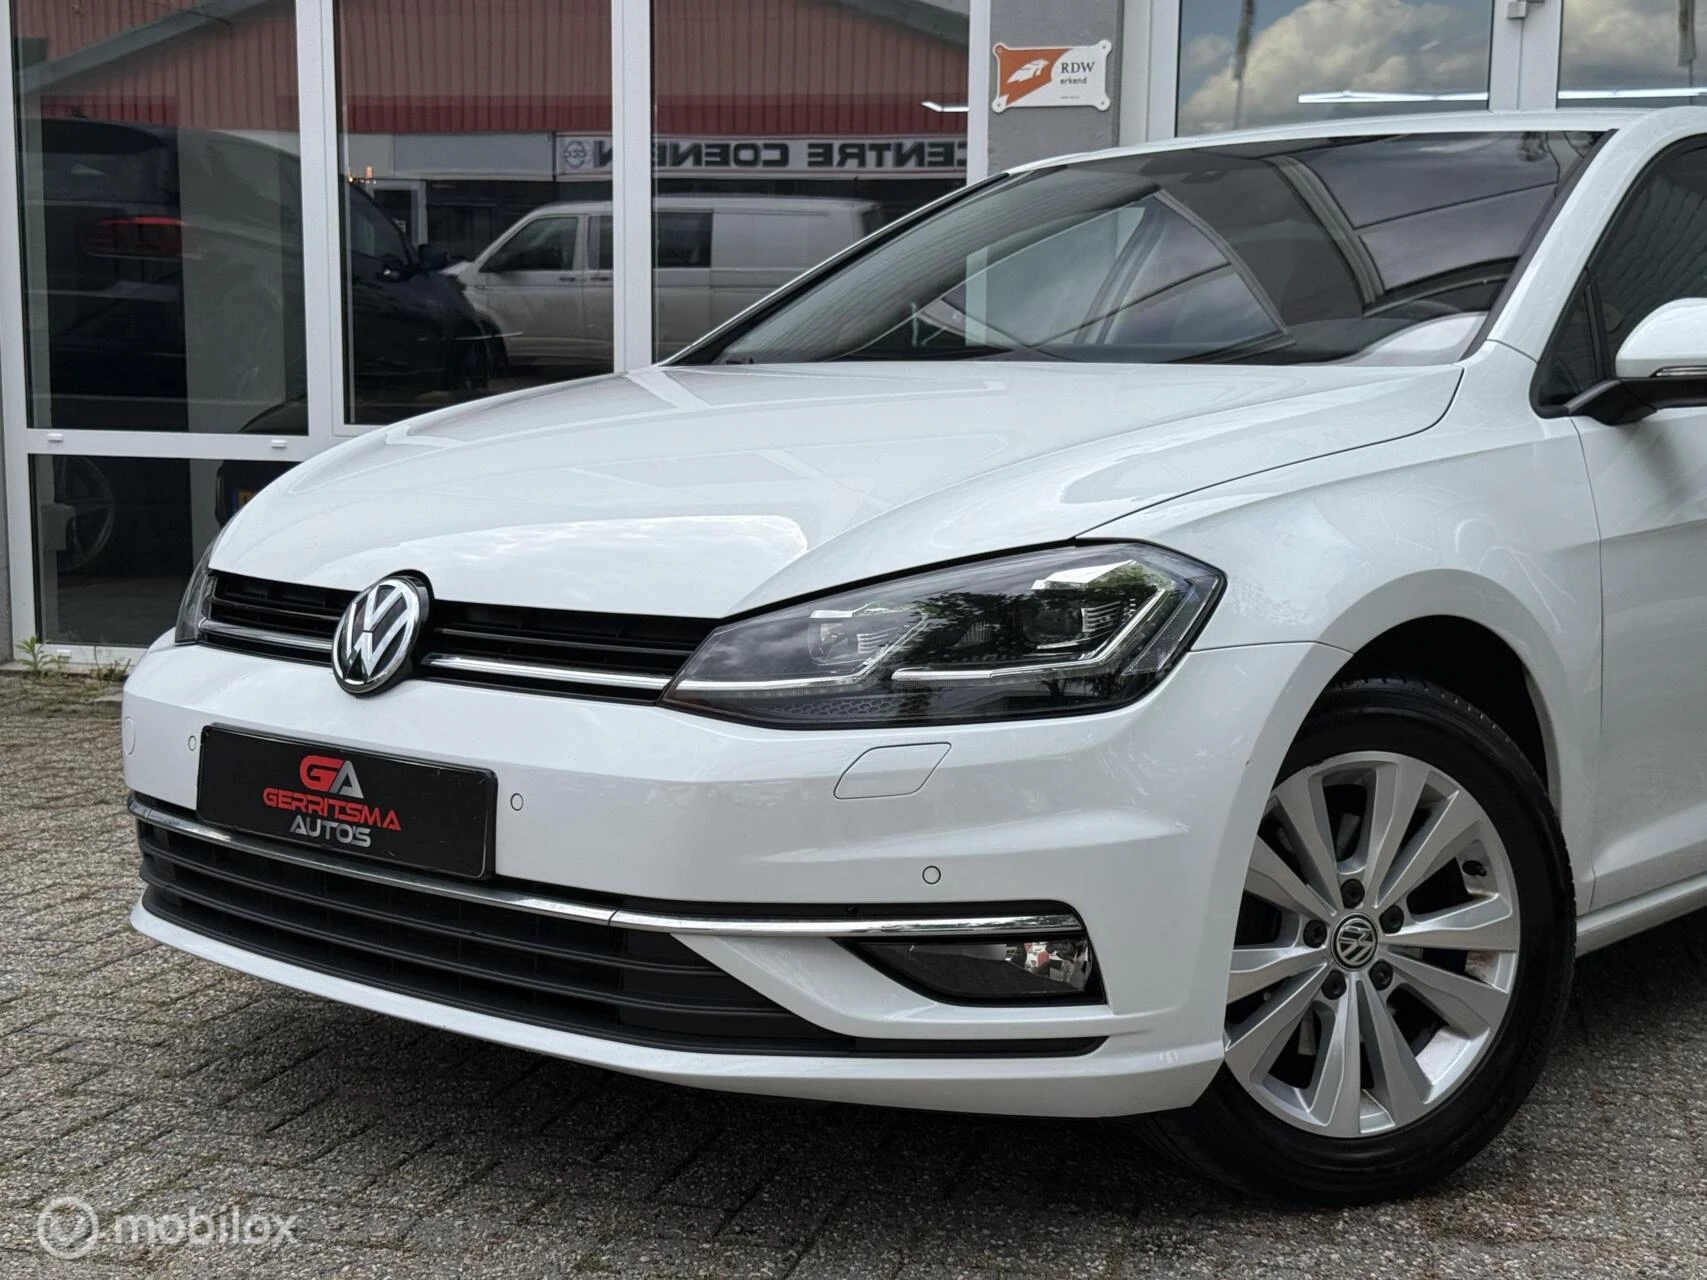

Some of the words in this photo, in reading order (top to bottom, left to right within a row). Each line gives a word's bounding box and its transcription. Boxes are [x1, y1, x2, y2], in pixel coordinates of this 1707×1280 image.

[1060, 61, 1096, 74] RDW
[1060, 77, 1087, 85] erkend
[300, 754, 364, 799] GA
[263, 787, 402, 832] GERRITSMA
[289, 814, 372, 848] AUTO'S
